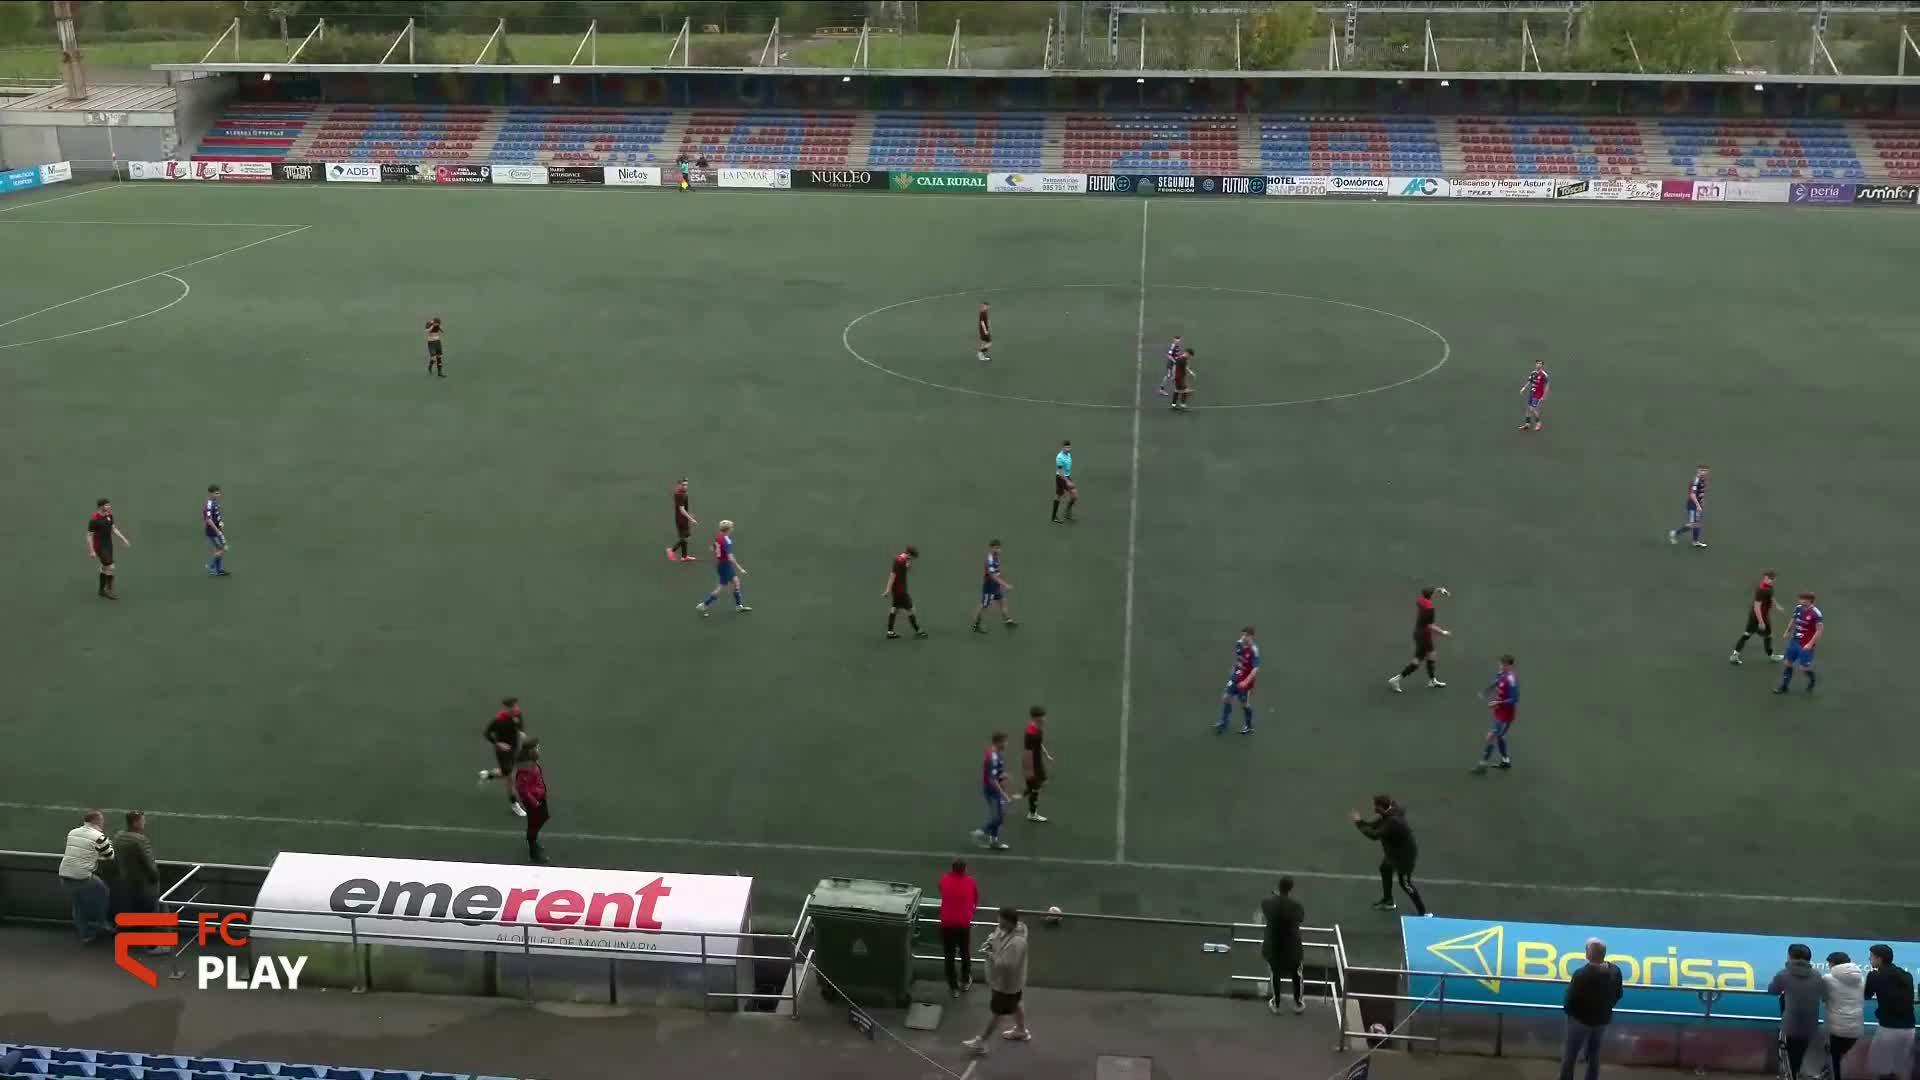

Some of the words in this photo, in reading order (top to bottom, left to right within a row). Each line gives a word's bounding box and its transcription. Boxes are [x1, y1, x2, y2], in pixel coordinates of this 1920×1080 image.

[346, 166, 377, 177] ADBT
[618, 168, 648, 180] Nieto's
[917, 177, 945, 187] CAJA
[947, 177, 986, 187] RURAL
[1157, 176, 1195, 188] SEGUNDA
[1267, 177, 1297, 185] HOTEL
[1452, 178, 1490, 187] Descanso
[1498, 179, 1522, 188] Hogar
[329, 876, 673, 932] emerent
